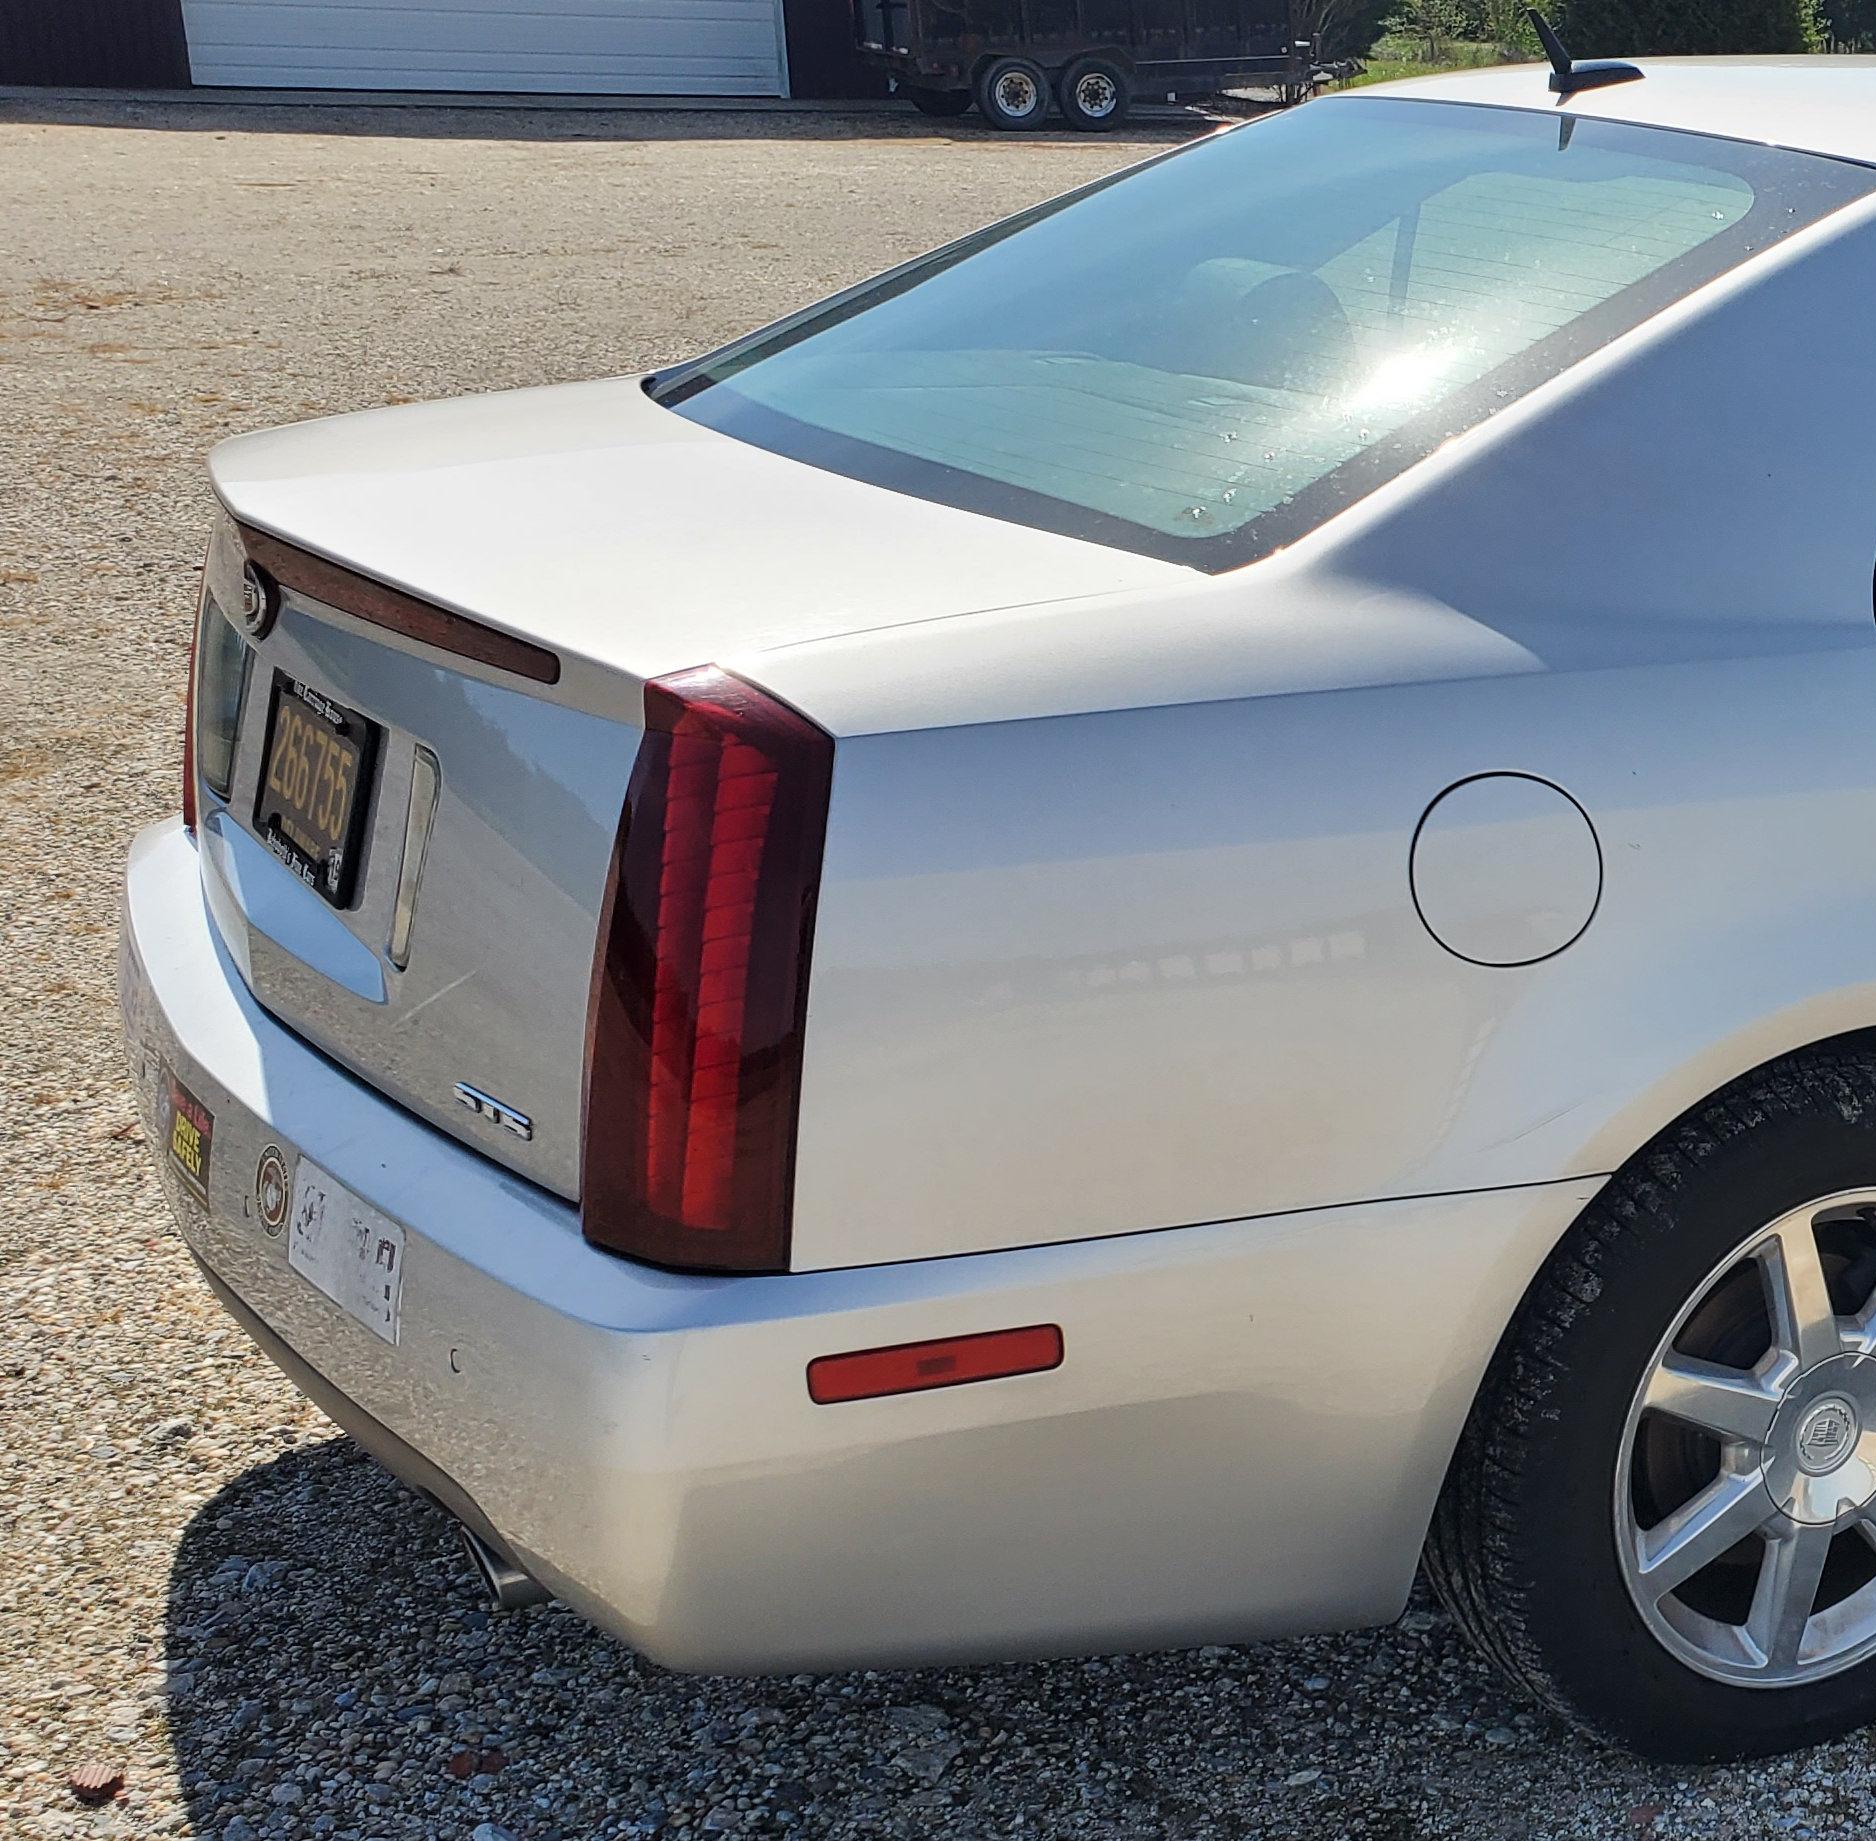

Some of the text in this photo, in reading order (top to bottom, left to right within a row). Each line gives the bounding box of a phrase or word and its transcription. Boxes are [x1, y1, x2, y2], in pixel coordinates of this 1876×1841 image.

[269, 705, 352, 840] 266755
[176, 1110, 201, 1154] DRIVE
[453, 1081, 532, 1141] STS
[172, 1130, 202, 1177] SAFELY
